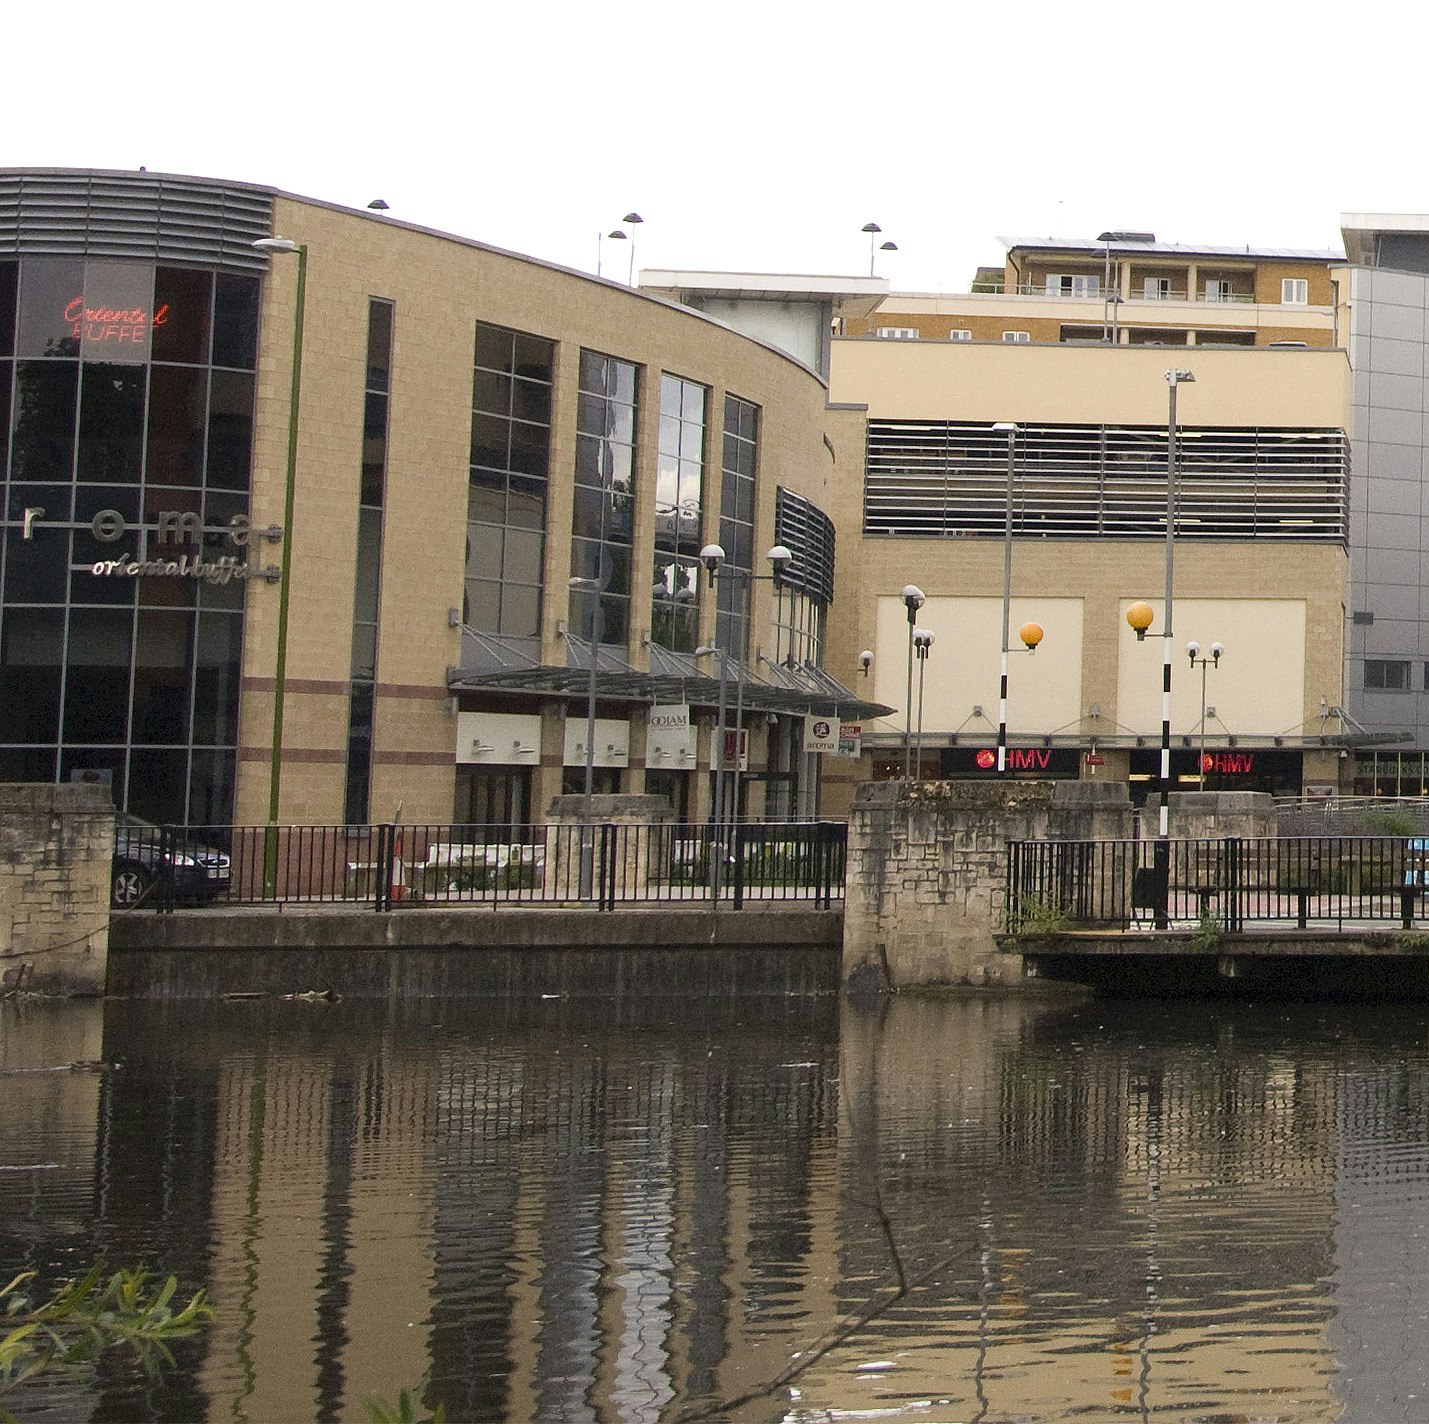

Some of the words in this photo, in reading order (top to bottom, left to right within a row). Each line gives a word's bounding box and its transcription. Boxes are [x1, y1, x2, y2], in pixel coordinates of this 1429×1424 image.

[1005, 749, 1053, 769] HMV
[1213, 754, 1254, 773] HMV
[1356, 764, 1413, 775] STARBUKS
